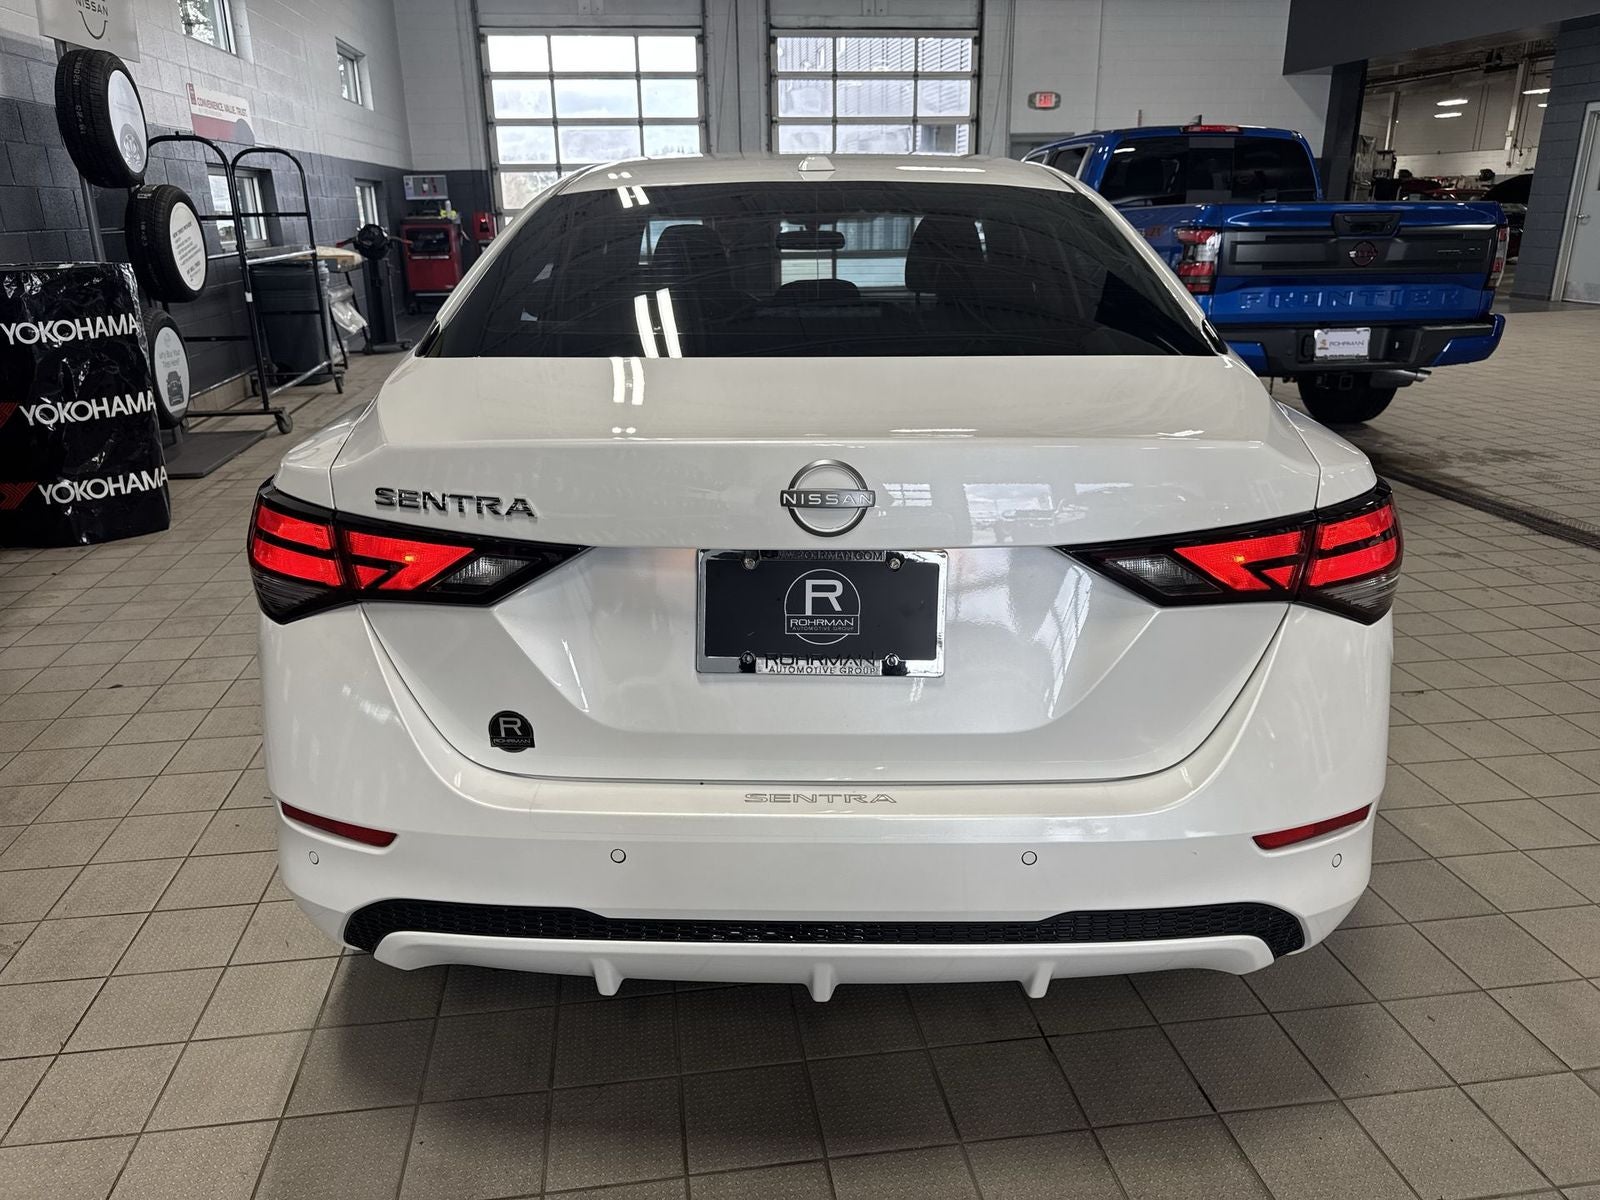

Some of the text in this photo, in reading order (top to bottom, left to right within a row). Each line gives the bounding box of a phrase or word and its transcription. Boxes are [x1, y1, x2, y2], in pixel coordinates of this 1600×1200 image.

[1239, 288, 1464, 309] FRONTIER
[0, 313, 140, 345] YOKOHAMA
[19, 390, 156, 426] YOKOHAMA
[38, 466, 168, 505] YOKOHAMA
[375, 487, 537, 519] SENTRA
[783, 493, 873, 505] NISSAN
[805, 579, 843, 615] R
[790, 617, 854, 628] ROHRMAN
[765, 652, 876, 668] ROHRMAN
[768, 666, 876, 675] AUTOMOTIVE GROUP
[499, 717, 522, 737] R
[744, 793, 897, 804] SENTRA
